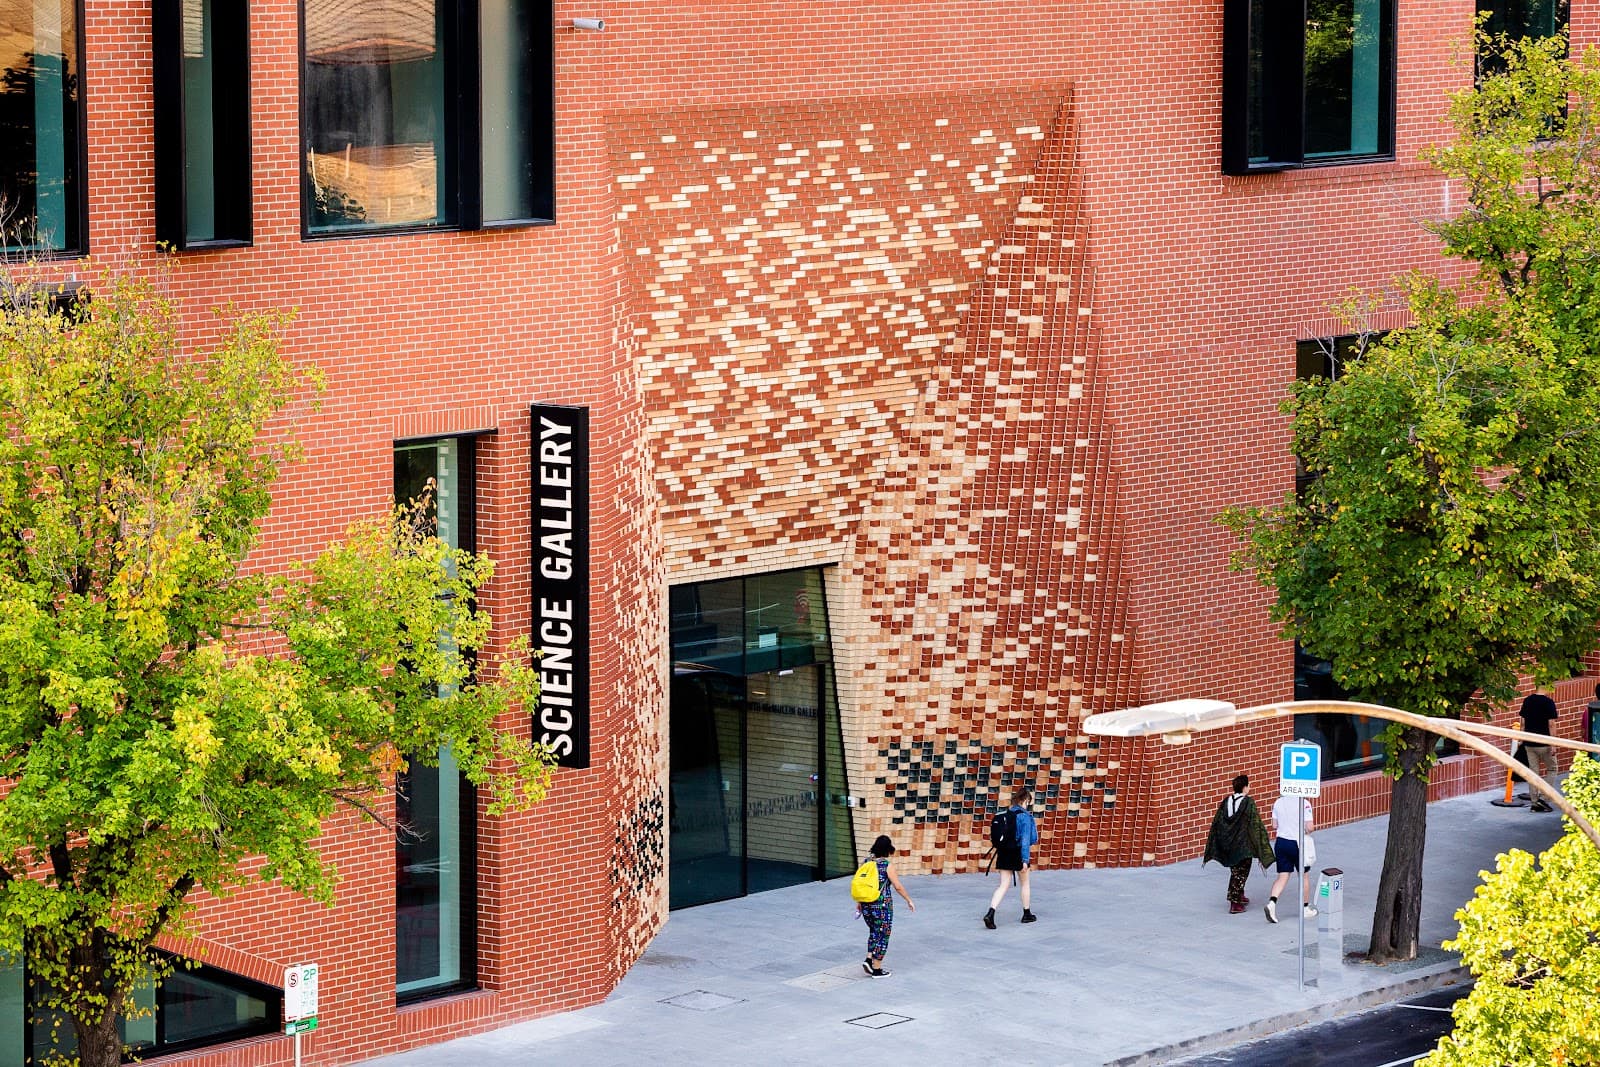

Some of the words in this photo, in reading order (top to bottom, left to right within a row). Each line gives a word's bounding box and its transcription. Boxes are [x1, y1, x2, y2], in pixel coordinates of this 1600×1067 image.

[540, 416, 573, 580] GALLERY
[540, 597, 573, 757] SCIENCE
[1290, 752, 1310, 775] P
[1282, 786, 1303, 794] AREA
[1304, 787, 1317, 795] 373
[303, 968, 317, 981] 2P
